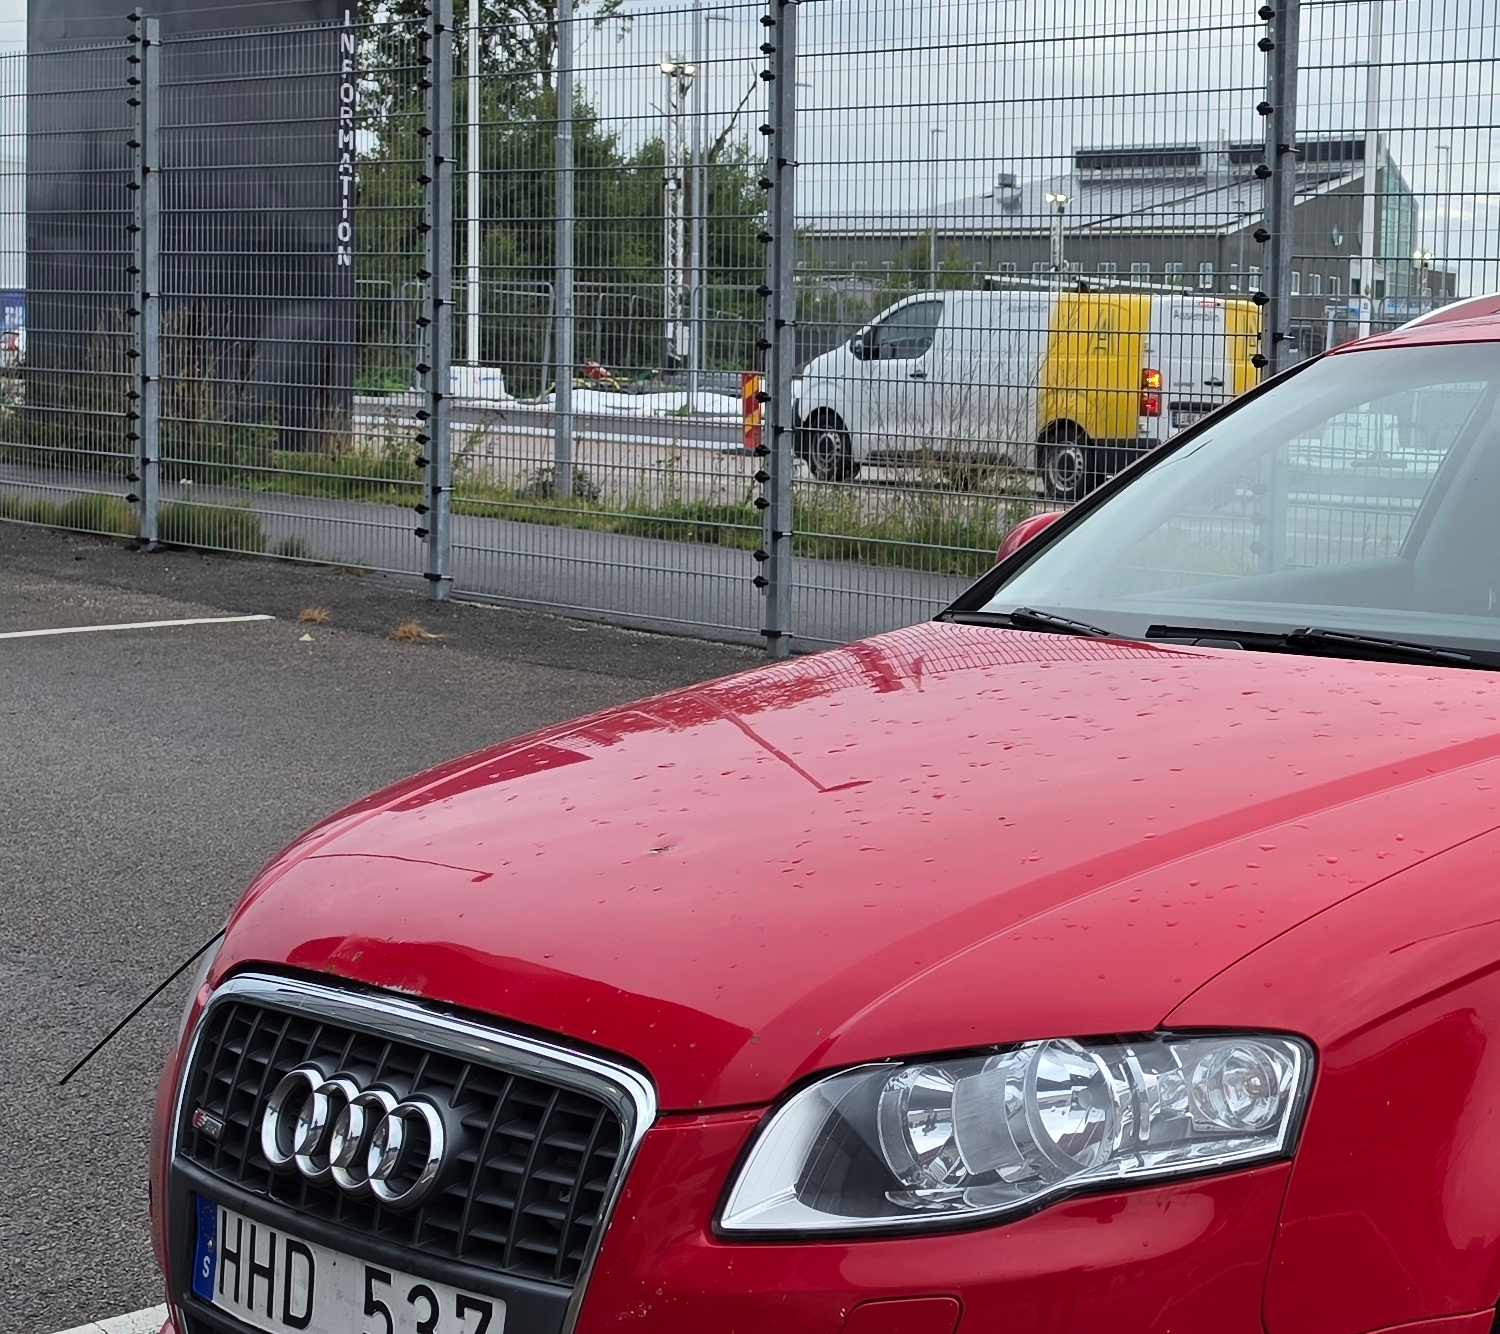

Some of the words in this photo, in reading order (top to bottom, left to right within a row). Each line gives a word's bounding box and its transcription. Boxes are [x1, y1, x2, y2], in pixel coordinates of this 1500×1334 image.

[337, 9, 355, 267] INFORMATION
[201, 1255, 211, 1279] S
[218, 1209, 316, 1331] HHD
